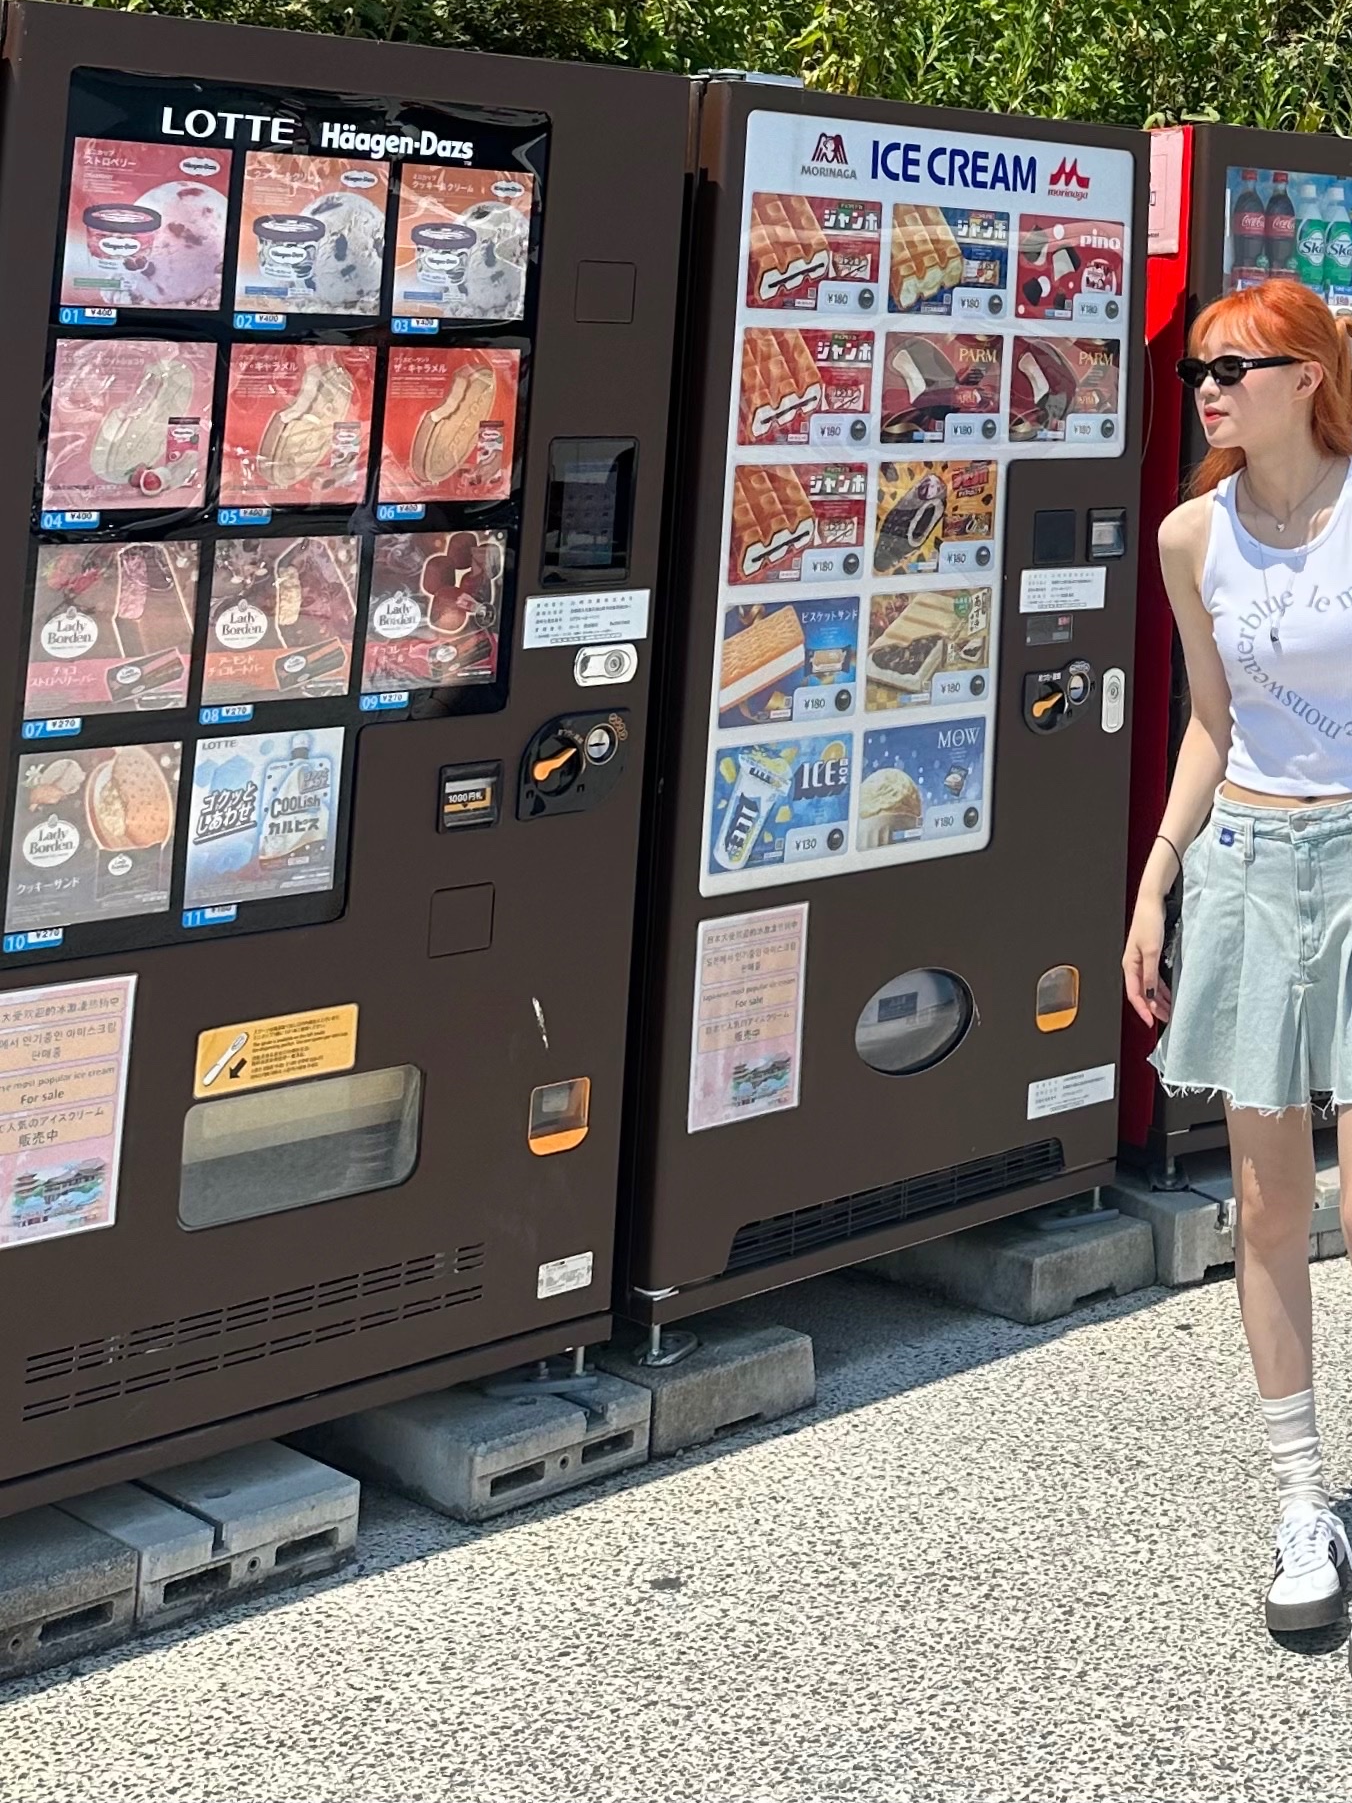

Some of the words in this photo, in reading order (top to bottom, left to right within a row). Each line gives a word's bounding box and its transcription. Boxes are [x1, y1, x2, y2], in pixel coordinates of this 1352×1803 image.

[161, 106, 295, 145] LOTTE
[321, 122, 474, 159] Häagen-Dazs
[83, 155, 137, 167] ストロベリー
[871, 140, 921, 184] ICE
[927, 146, 1037, 195] CREAM
[800, 165, 858, 181] MORINAGA
[1047, 188, 1089, 202] morinaga
[1079, 228, 1121, 250] pino
[826, 292, 849, 305] ¥180
[960, 297, 980, 309] ¥180
[61, 310, 79, 323] 01
[235, 315, 252, 328] 02
[393, 320, 408, 333] 03
[958, 347, 998, 364] PARM
[1077, 350, 1115, 367] PARM
[819, 426, 842, 437] ¥180
[952, 424, 973, 436] ¥180
[220, 509, 237, 524] 05
[379, 506, 395, 520] 06
[43, 515, 63, 528] 04
[812, 560, 834, 572] ¥180
[946, 553, 967, 565] ¥180
[386, 602, 413, 616] Lady
[229, 612, 255, 626] Lady
[801, 609, 859, 625] ビスケットサンド
[56, 620, 87, 633] Lady
[222, 622, 264, 636] Borden
[47, 631, 93, 646] Borden
[940, 682, 961, 694] ¥180
[362, 696, 378, 710] 09
[804, 697, 826, 710] ¥180
[201, 709, 219, 723] 08
[225, 707, 247, 715] ¥270
[24, 723, 43, 737] 07
[51, 720, 75, 728] ¥270
[202, 739, 237, 750] LOTTE
[937, 727, 981, 749] MOW
[801, 759, 837, 790] ICE
[839, 758, 849, 785] BOX
[197, 799, 257, 836] しあわせ
[268, 817, 320, 835] カルピス
[38, 826, 67, 842] Lady
[29, 840, 73, 854] Borden
[794, 837, 818, 851] ¥130
[16, 876, 81, 895] クッキーサンド
[185, 912, 201, 925] 11
[7, 935, 25, 949] 10
[735, 999, 748, 1009] For
[38, 1072, 72, 1087] popular
[74, 1072, 86, 1080] ice
[88, 1066, 115, 1077] cream
[20, 1093, 40, 1105] For
[42, 1089, 65, 1100] sale
[18, 1129, 59, 1149] 販売中
